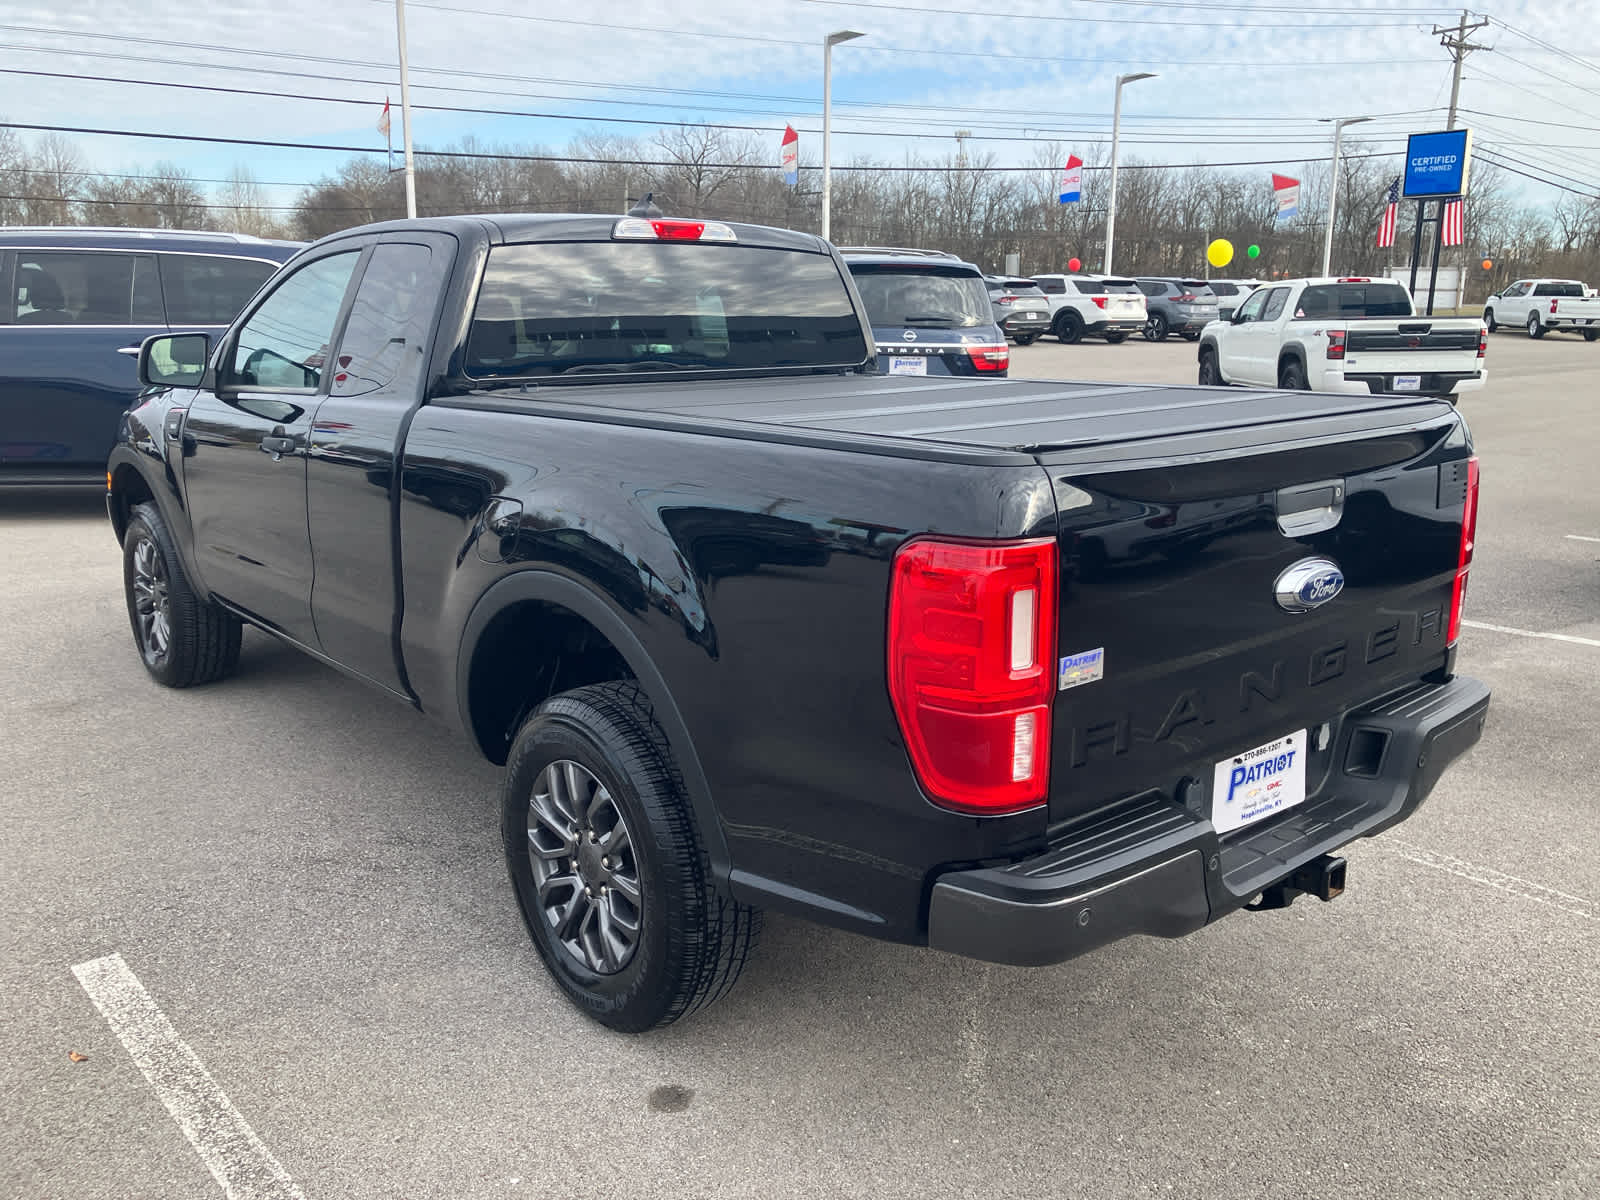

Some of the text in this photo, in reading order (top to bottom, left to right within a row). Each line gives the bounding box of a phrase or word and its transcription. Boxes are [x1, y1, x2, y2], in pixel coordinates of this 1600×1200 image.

[1411, 155, 1457, 167] CERTIFIED
[1414, 164, 1453, 173] PRE-OWNED
[1310, 575, 1338, 599] Ford
[1062, 651, 1102, 676] PATRIOT
[1069, 603, 1444, 769] RANGER
[1227, 751, 1296, 802] PATRIOT
